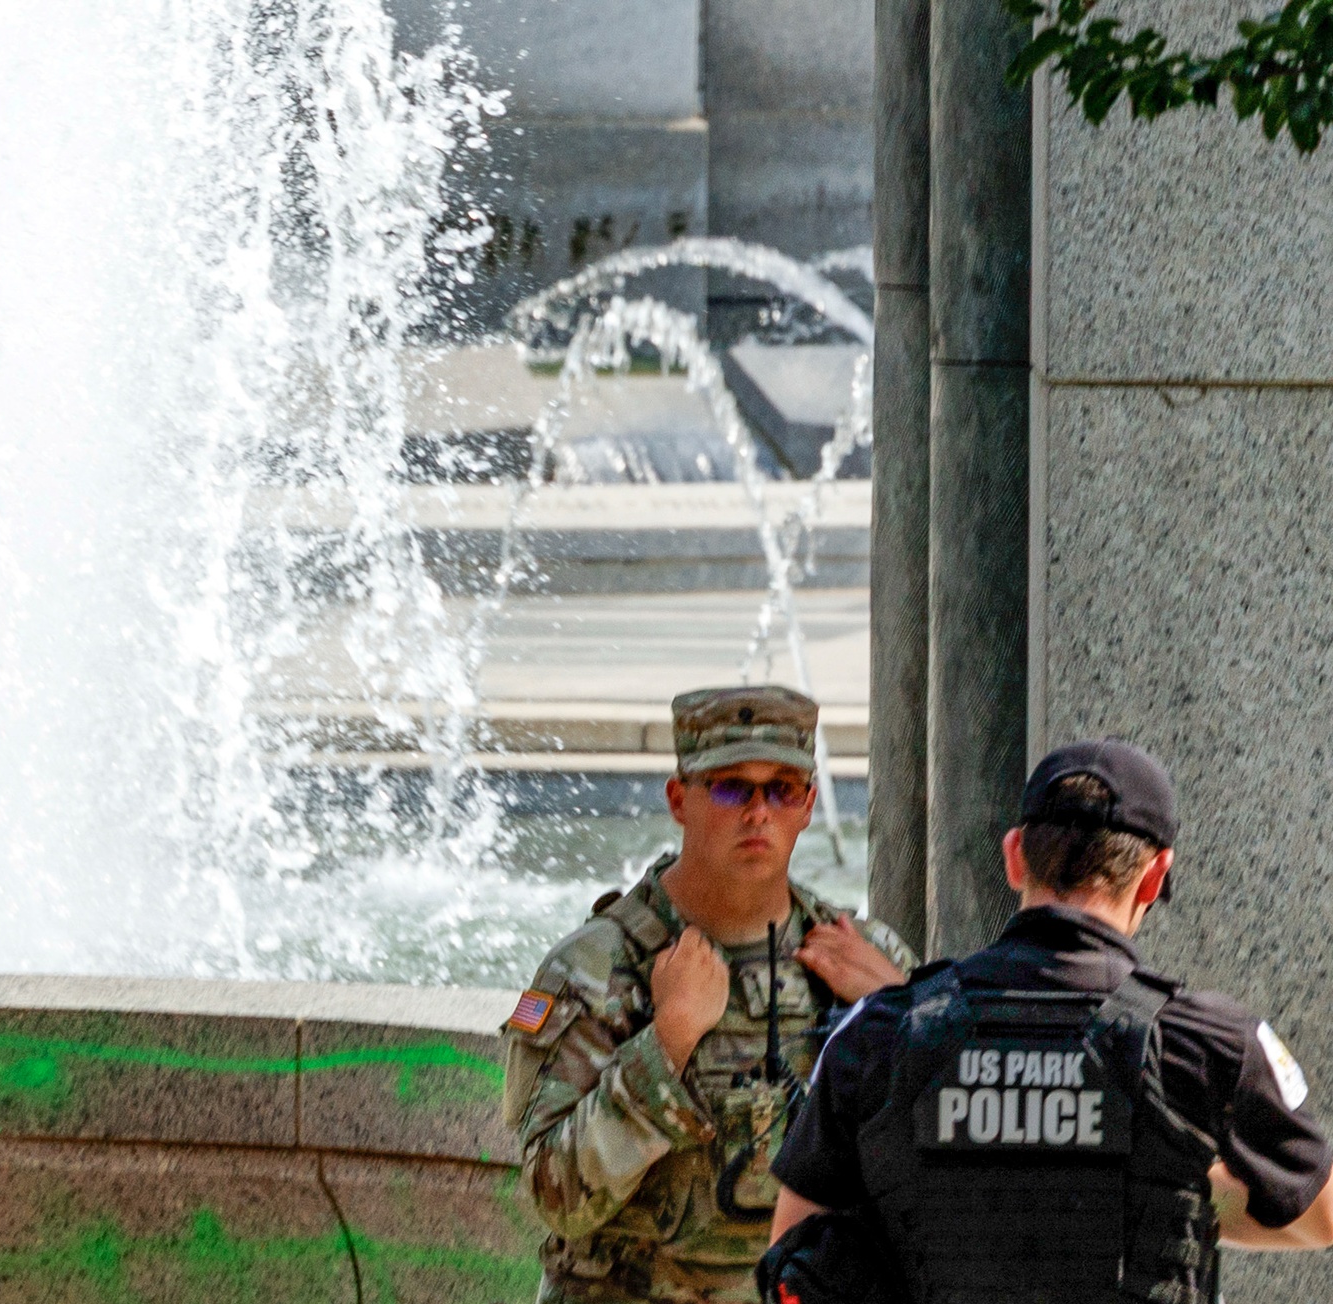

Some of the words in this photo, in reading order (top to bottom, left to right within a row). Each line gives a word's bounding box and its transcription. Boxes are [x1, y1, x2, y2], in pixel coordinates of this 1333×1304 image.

[959, 1049, 1002, 1086] US
[1004, 1050, 1085, 1087] PARK
[937, 1087, 1104, 1146] POLICE
